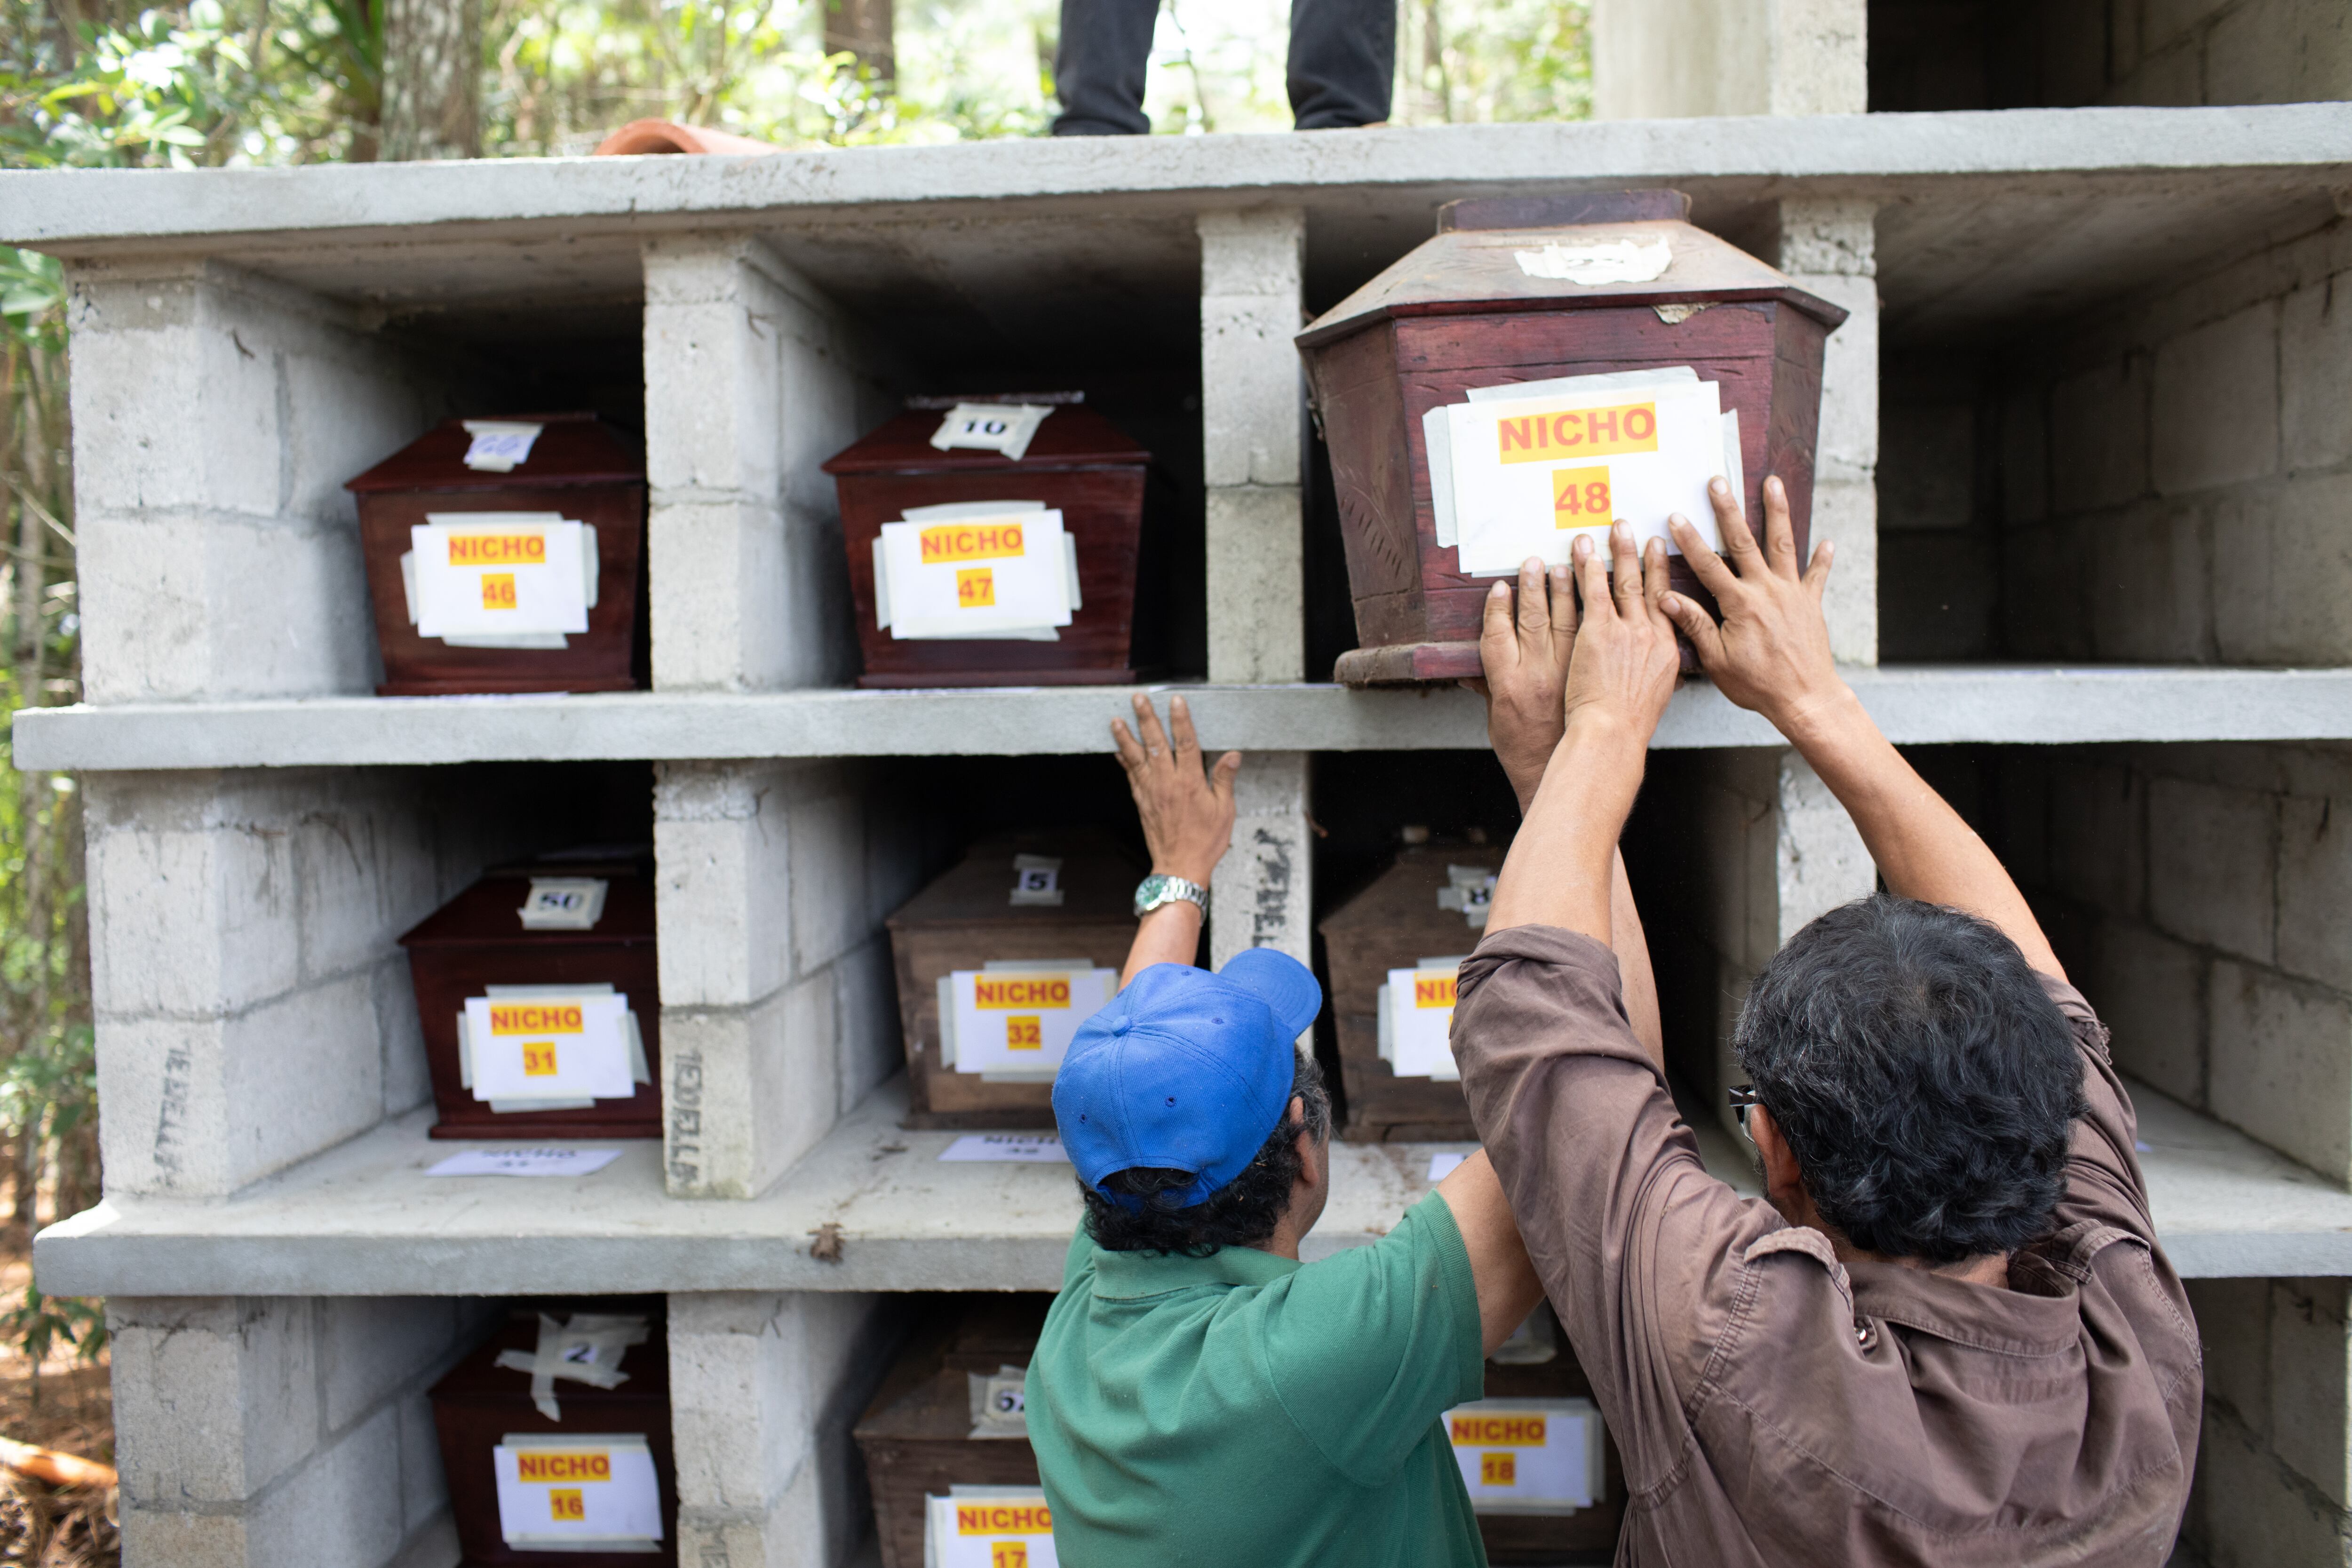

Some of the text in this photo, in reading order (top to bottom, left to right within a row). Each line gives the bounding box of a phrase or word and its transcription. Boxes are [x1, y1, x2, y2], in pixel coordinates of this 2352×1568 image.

[1500, 408, 1655, 452] NICHO
[1554, 482, 1610, 516] 48
[449, 537, 545, 558] NICHO
[921, 528, 1022, 556] NICHO
[482, 583, 516, 602] 46
[958, 578, 992, 598] 47
[1027, 872, 1047, 891] 5
[975, 981, 1070, 1003] NICHO
[491, 1009, 582, 1029] NICHO
[1008, 1024, 1041, 1044] 32
[524, 1051, 556, 1070] 31
[1451, 1419, 1545, 1441] NICHO
[518, 1456, 610, 1477] NICHO
[1483, 1461, 1514, 1480] 18
[552, 1497, 584, 1515] 16
[957, 1508, 1052, 1529] NICHO
[993, 1551, 1027, 1568] 17
